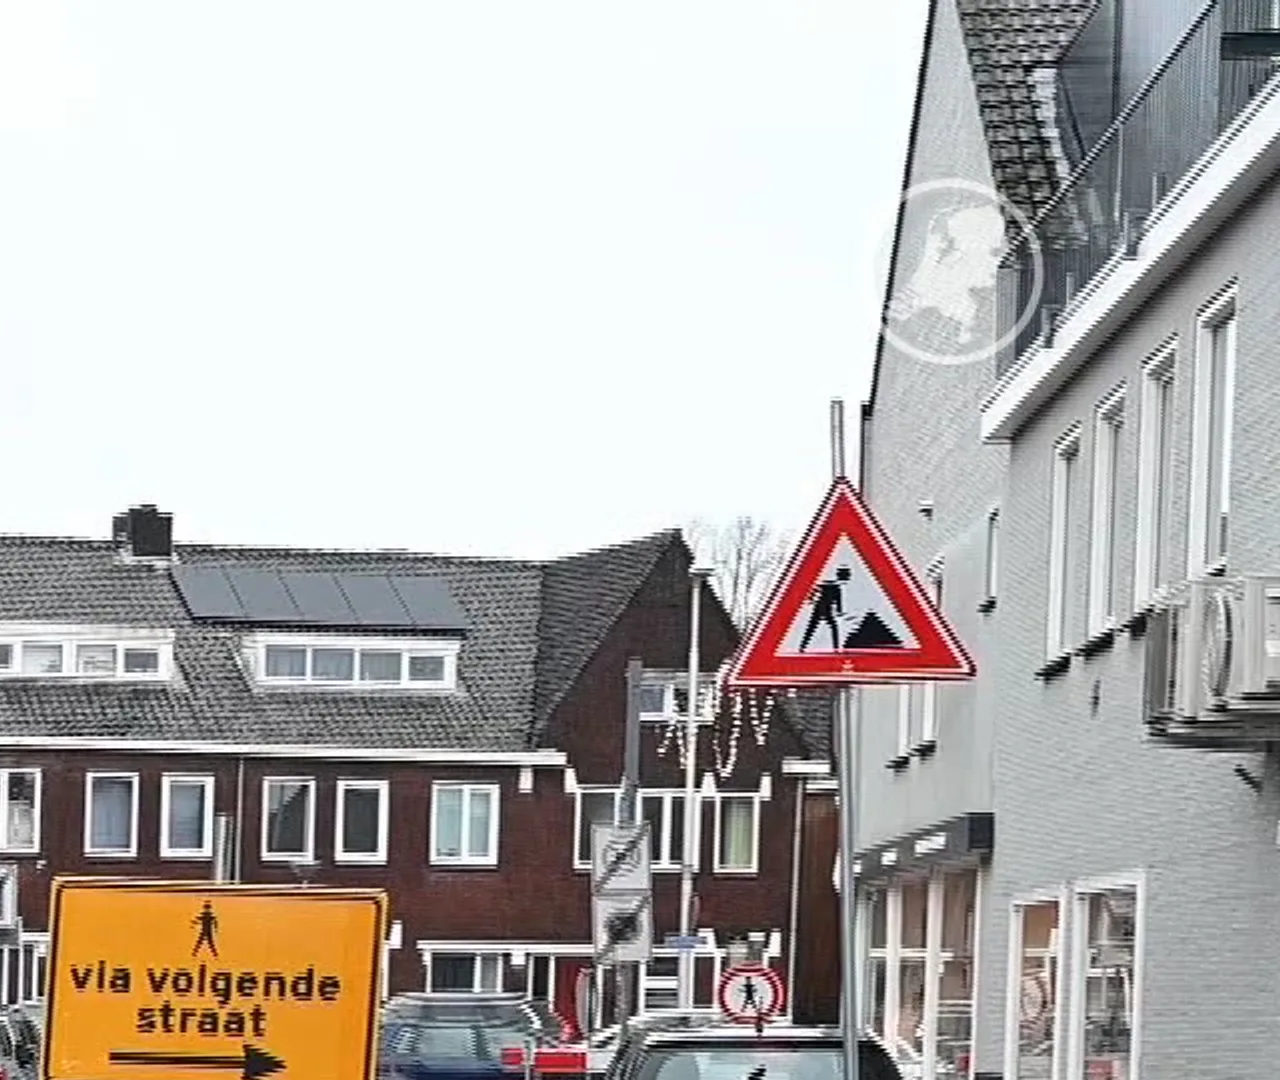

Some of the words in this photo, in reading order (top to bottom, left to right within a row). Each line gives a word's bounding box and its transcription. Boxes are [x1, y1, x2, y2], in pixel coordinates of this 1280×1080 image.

[69, 959, 132, 994] via
[145, 963, 341, 1008] volgende
[136, 1001, 267, 1037] straat
